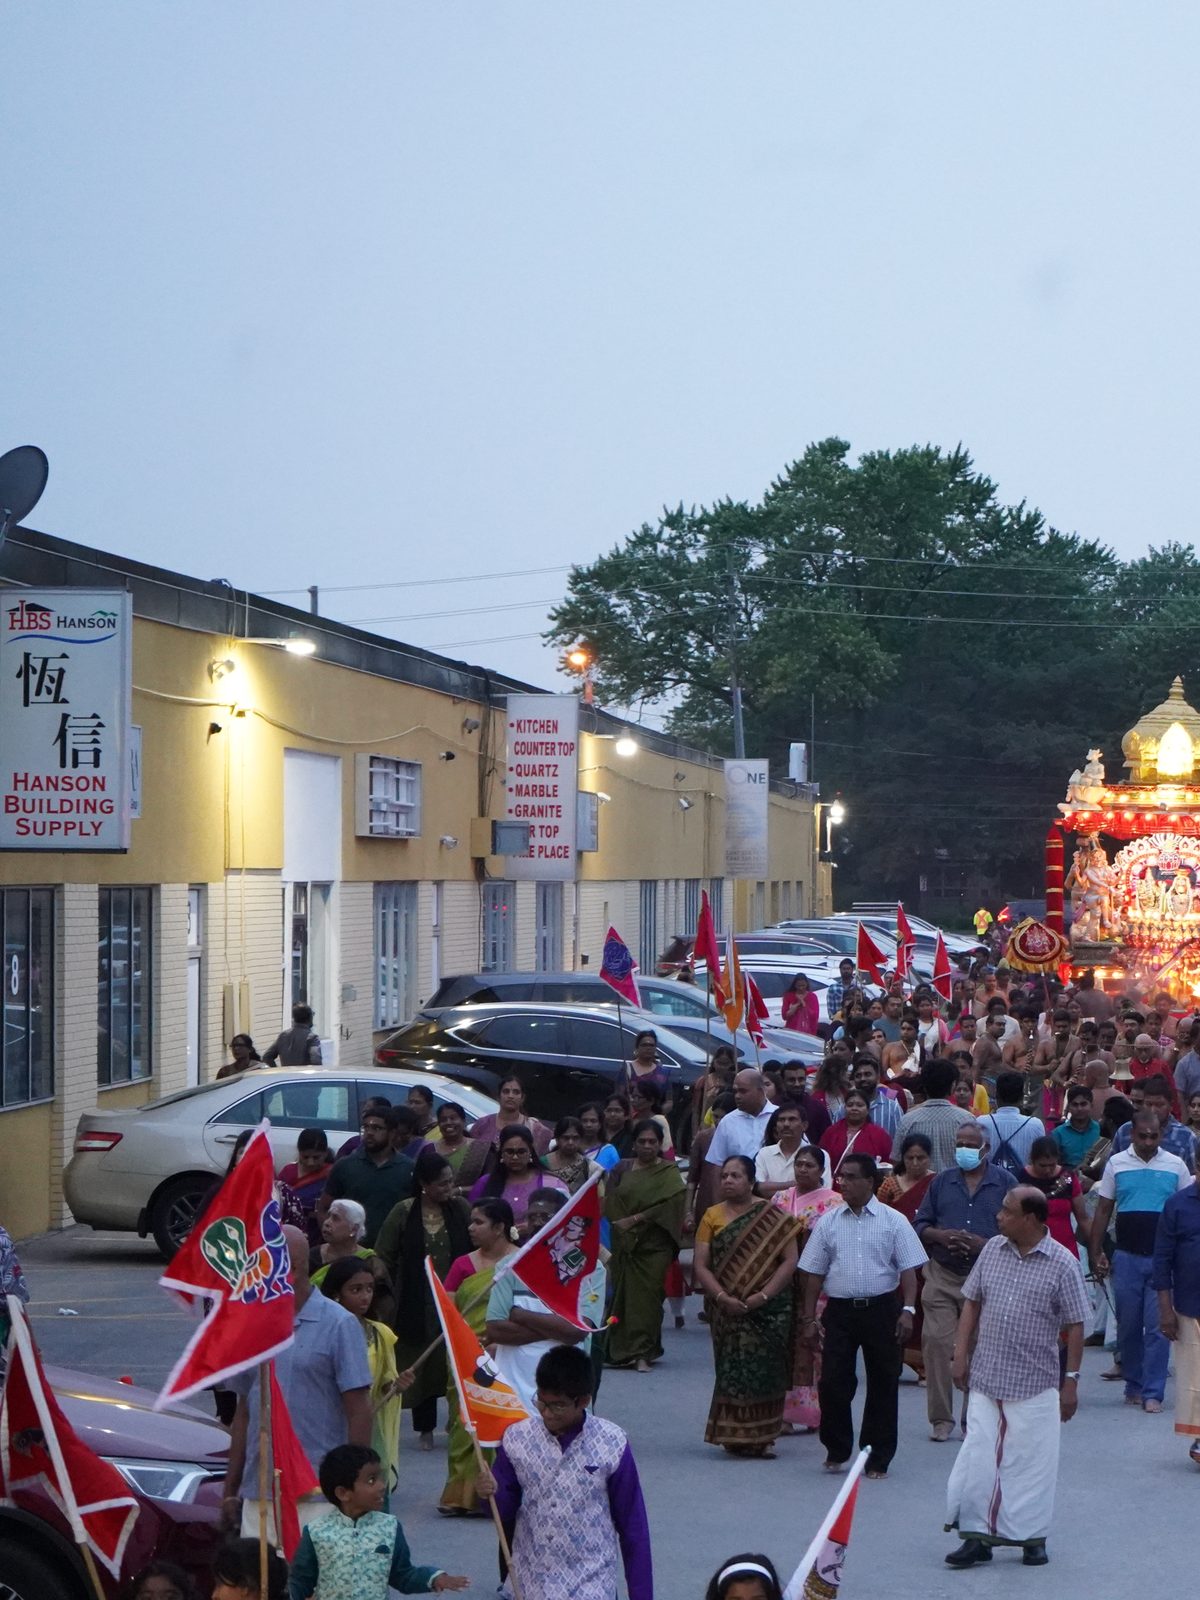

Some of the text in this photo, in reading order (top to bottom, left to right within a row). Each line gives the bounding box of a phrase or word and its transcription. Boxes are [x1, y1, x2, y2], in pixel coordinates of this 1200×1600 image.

[9, 600, 116, 630] HBS HANSON
[516, 719, 558, 734] KITCHEN
[514, 741, 575, 756] COUNTER TOP
[515, 764, 559, 777] QUARTZ
[13, 772, 106, 791] HANSON
[515, 784, 558, 798] MARBLE
[5, 795, 114, 814] BUILDING
[514, 804, 562, 818] GRANITE
[16, 818, 103, 836] SUPPLY
[539, 825, 559, 838] TOP
[538, 845, 569, 859] PLACE
[11, 954, 19, 995] 8
